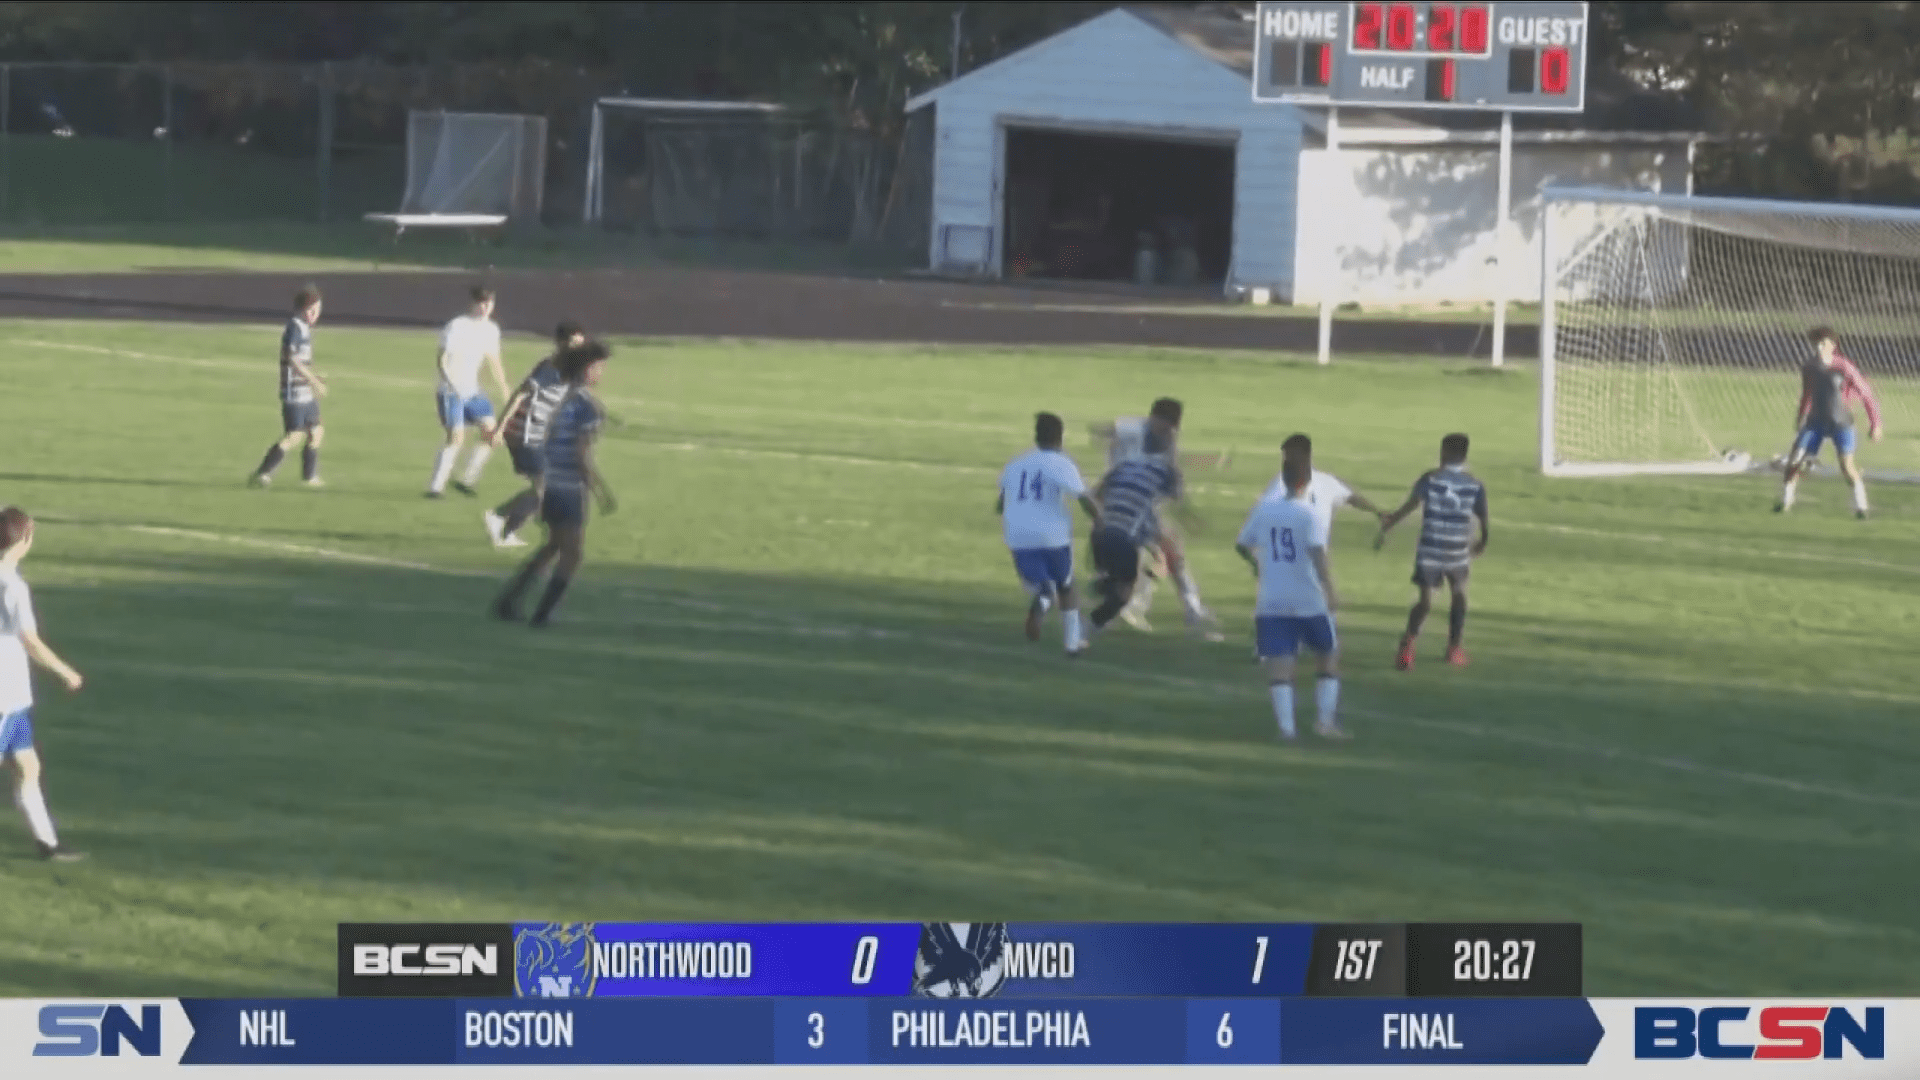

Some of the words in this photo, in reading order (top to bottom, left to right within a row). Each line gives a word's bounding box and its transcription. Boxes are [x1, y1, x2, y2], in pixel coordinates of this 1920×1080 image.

[1264, 10, 1338, 39] HOME
[1499, 17, 1584, 45] GUEST
[1361, 66, 1415, 88] HALF
[1540, 48, 1569, 93] 0
[1018, 470, 1043, 501] 14
[1270, 526, 1297, 563] 19
